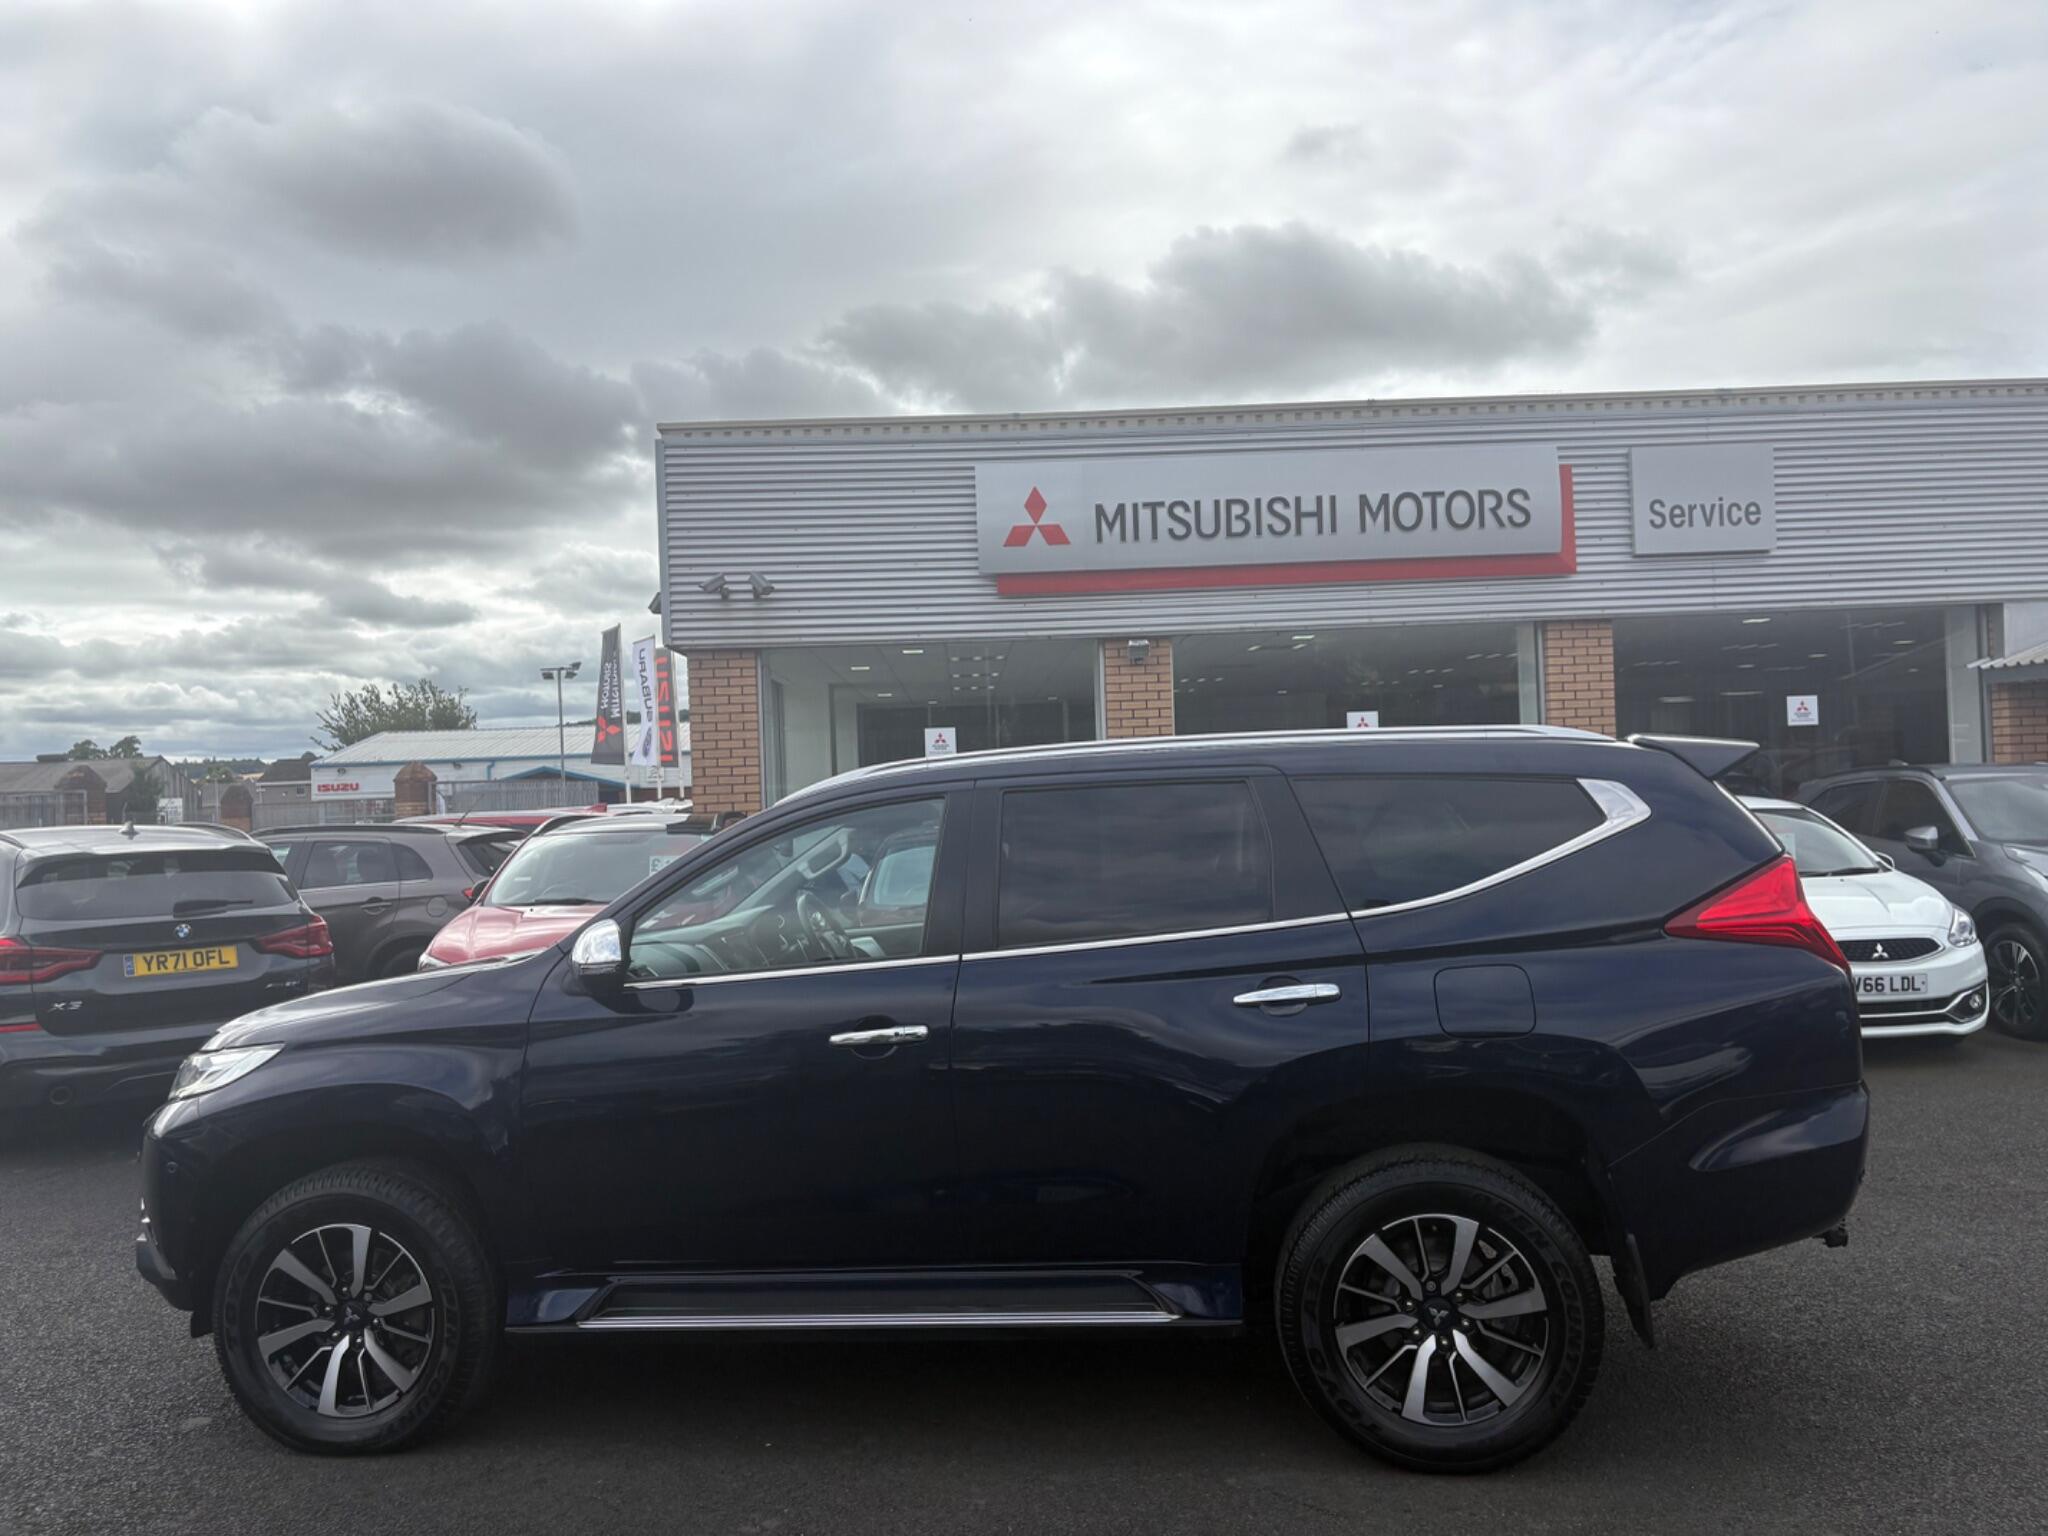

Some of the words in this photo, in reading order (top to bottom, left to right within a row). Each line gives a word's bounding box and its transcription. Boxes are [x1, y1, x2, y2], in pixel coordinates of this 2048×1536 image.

[1095, 495, 1337, 543] MITSUBISHI
[1359, 488, 1531, 533] MOTORS
[1649, 497, 1761, 529] Service
[317, 782, 360, 793] ISUZU
[142, 952, 188, 972] YR71
[192, 949, 231, 967] OFL
[1890, 976, 1921, 992] LDL
